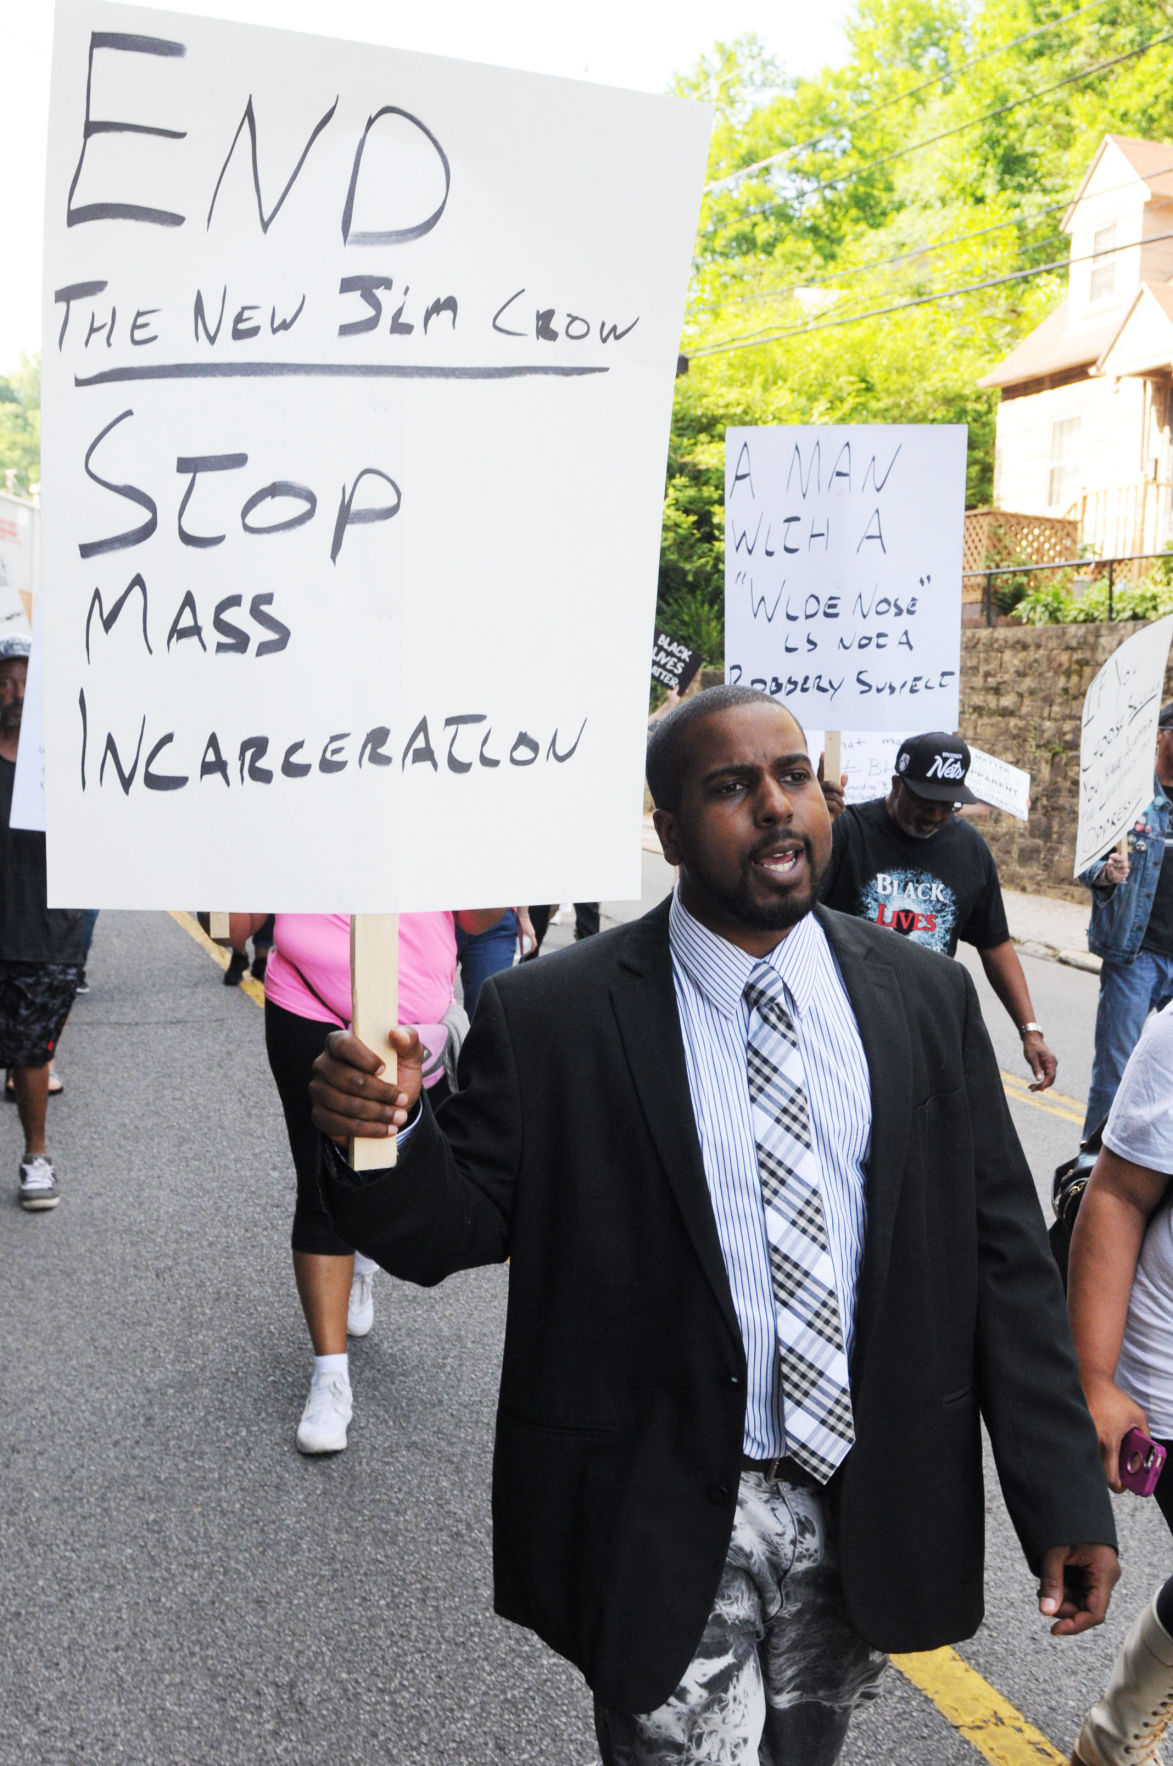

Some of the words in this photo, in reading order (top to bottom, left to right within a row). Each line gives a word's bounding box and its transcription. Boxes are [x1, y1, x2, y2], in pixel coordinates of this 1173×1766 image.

[67, 31, 450, 246] END
[55, 280, 162, 352] THE
[193, 285, 306, 346] NEW
[337, 274, 459, 338] JIM
[492, 288, 640, 345] CROW
[729, 441, 755, 499] A
[786, 440, 902, 500] MAN
[78, 408, 402, 566] STOP
[731, 511, 830, 557] WITH
[857, 508, 887, 555] A
[86, 572, 291, 665] MASS
[657, 633, 693, 662] BLACK
[785, 632, 818, 654] IS
[652, 646, 685, 674] LIVES
[651, 665, 680, 689] ATTER
[855, 670, 956, 696] SUSPECT
[79, 686, 588, 797] INCARCERATION
[926, 754, 965, 780] Nets
[875, 873, 945, 901] BLACK
[876, 903, 938, 932] LIVES
